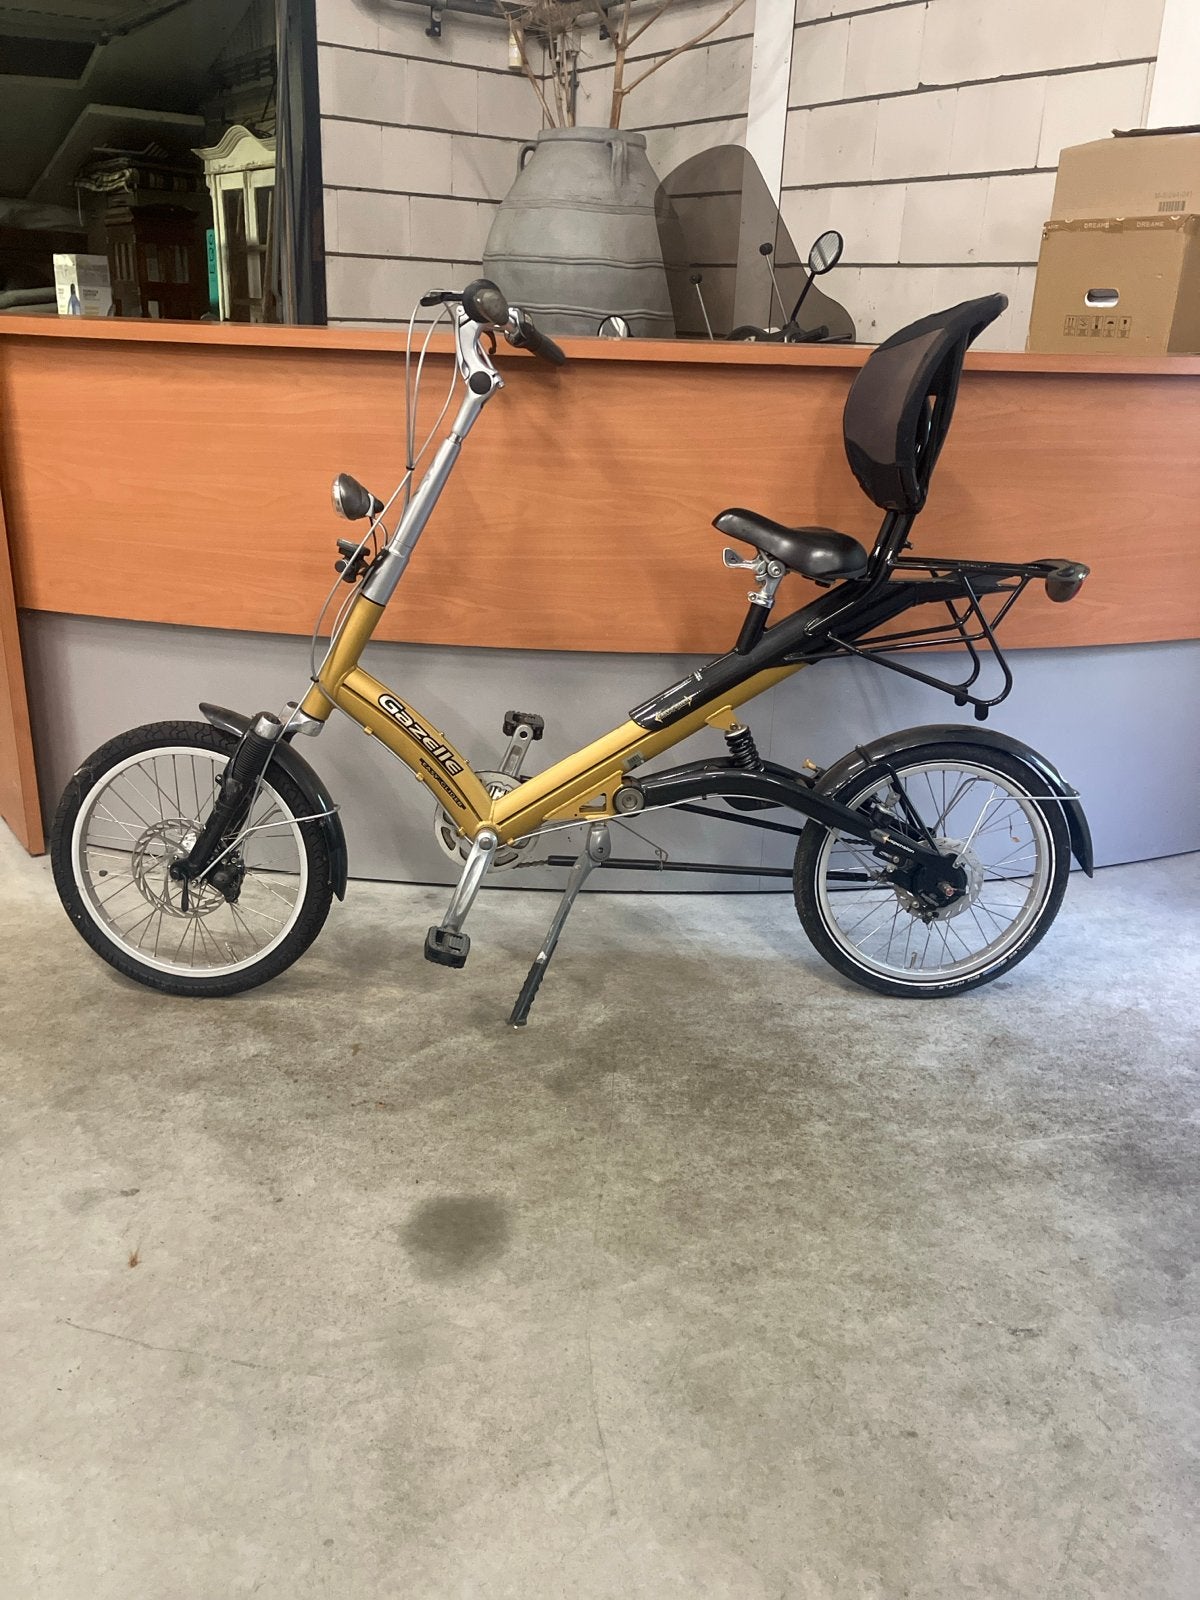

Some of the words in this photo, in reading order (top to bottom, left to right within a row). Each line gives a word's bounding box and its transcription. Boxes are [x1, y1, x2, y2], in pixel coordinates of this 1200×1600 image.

[1083, 221, 1110, 229] DREAME
[378, 694, 464, 776] Gazelle
[422, 760, 441, 781] EASY
